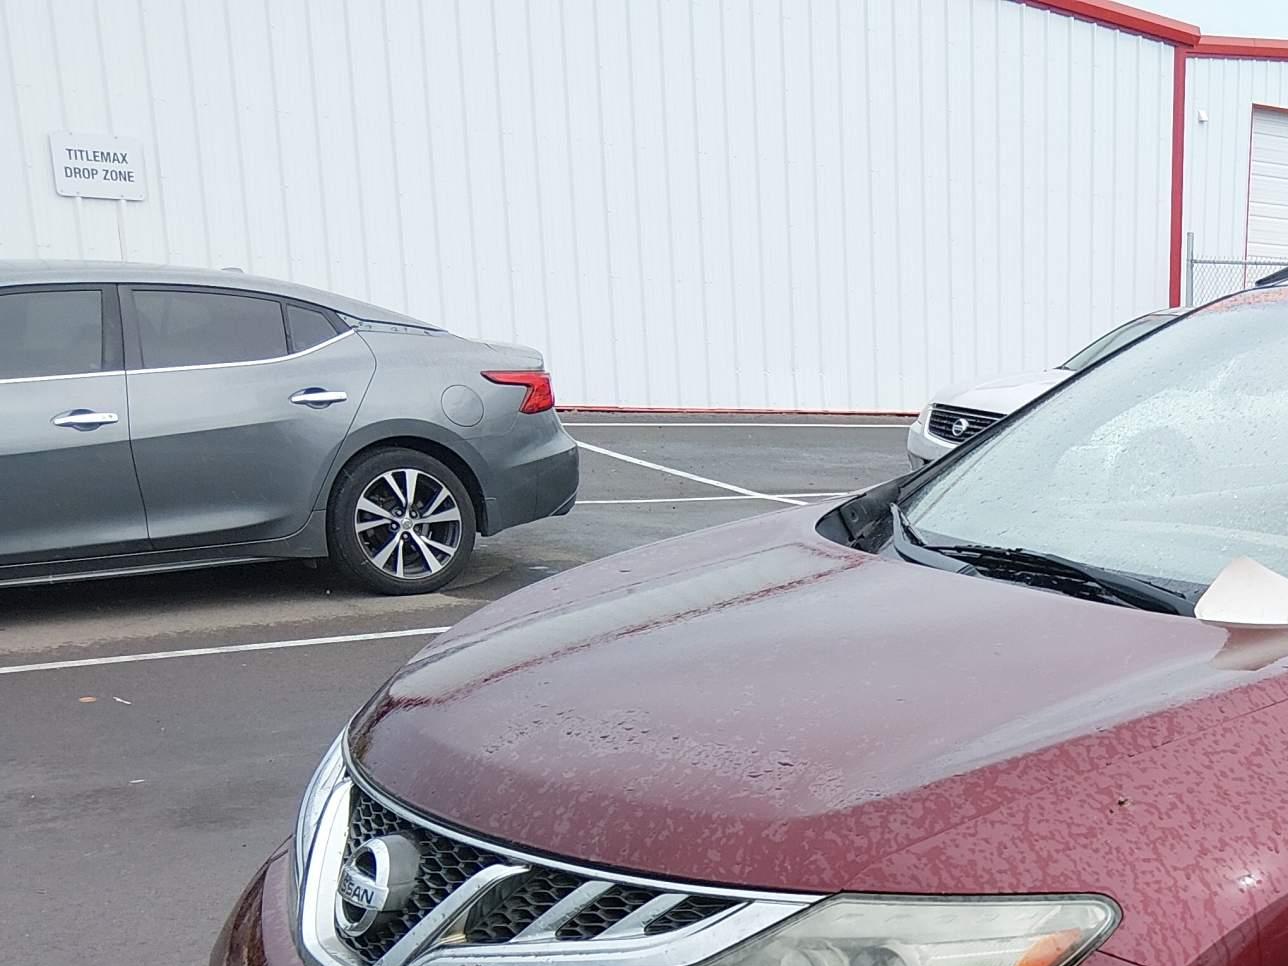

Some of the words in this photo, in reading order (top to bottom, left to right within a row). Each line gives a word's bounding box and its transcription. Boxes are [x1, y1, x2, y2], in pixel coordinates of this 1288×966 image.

[65, 148, 128, 164] TITLEMAX
[64, 166, 98, 180] DROP
[102, 168, 135, 182] ZONE
